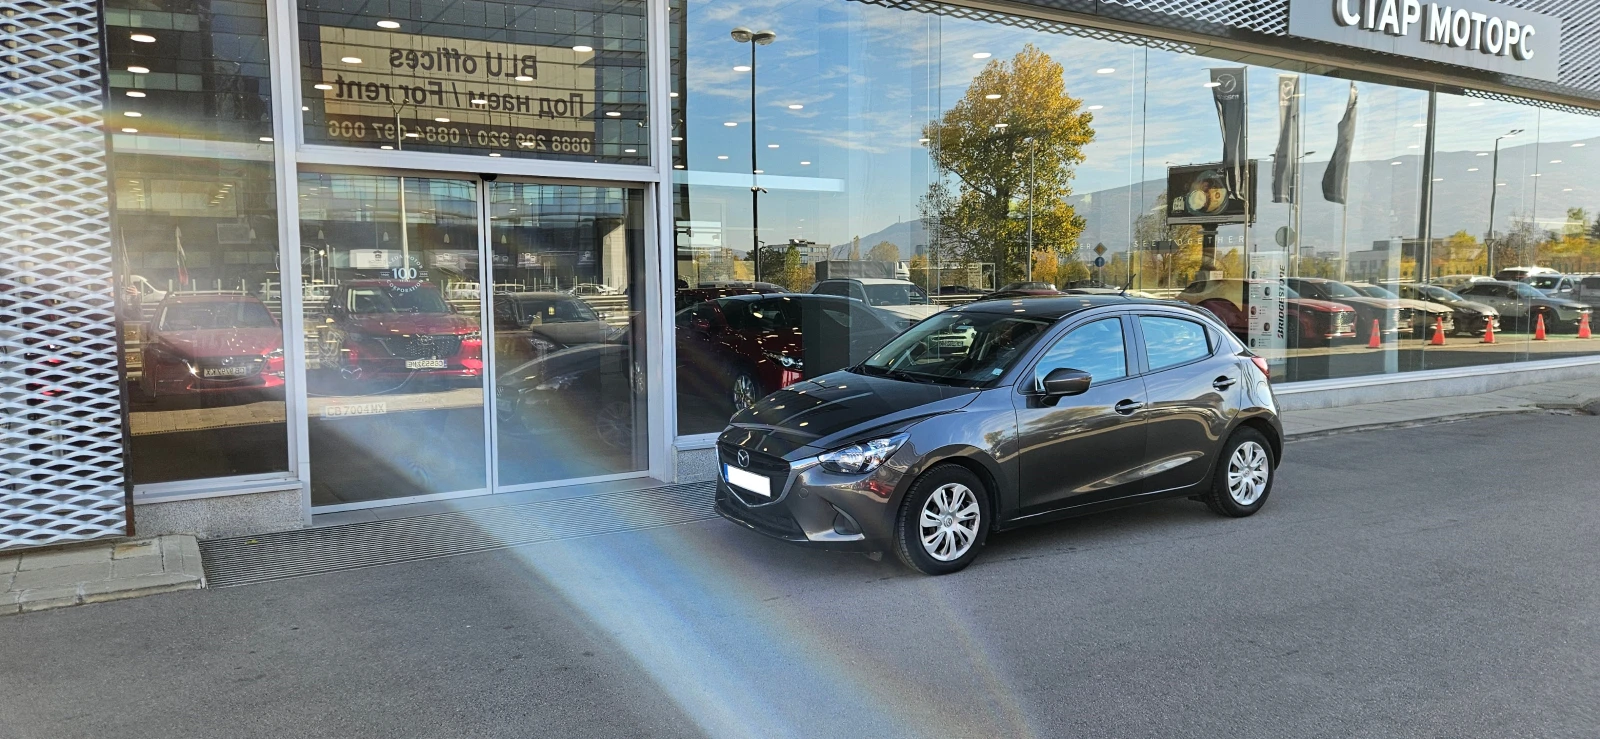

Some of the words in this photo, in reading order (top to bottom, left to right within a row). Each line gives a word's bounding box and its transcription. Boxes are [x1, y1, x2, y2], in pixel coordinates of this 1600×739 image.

[1334, 0, 1420, 36] СТАР
[1423, 3, 1536, 60] МОТОРС
[391, 267, 417, 279] 100
[1277, 264, 1286, 340] BRIDGESTONE
